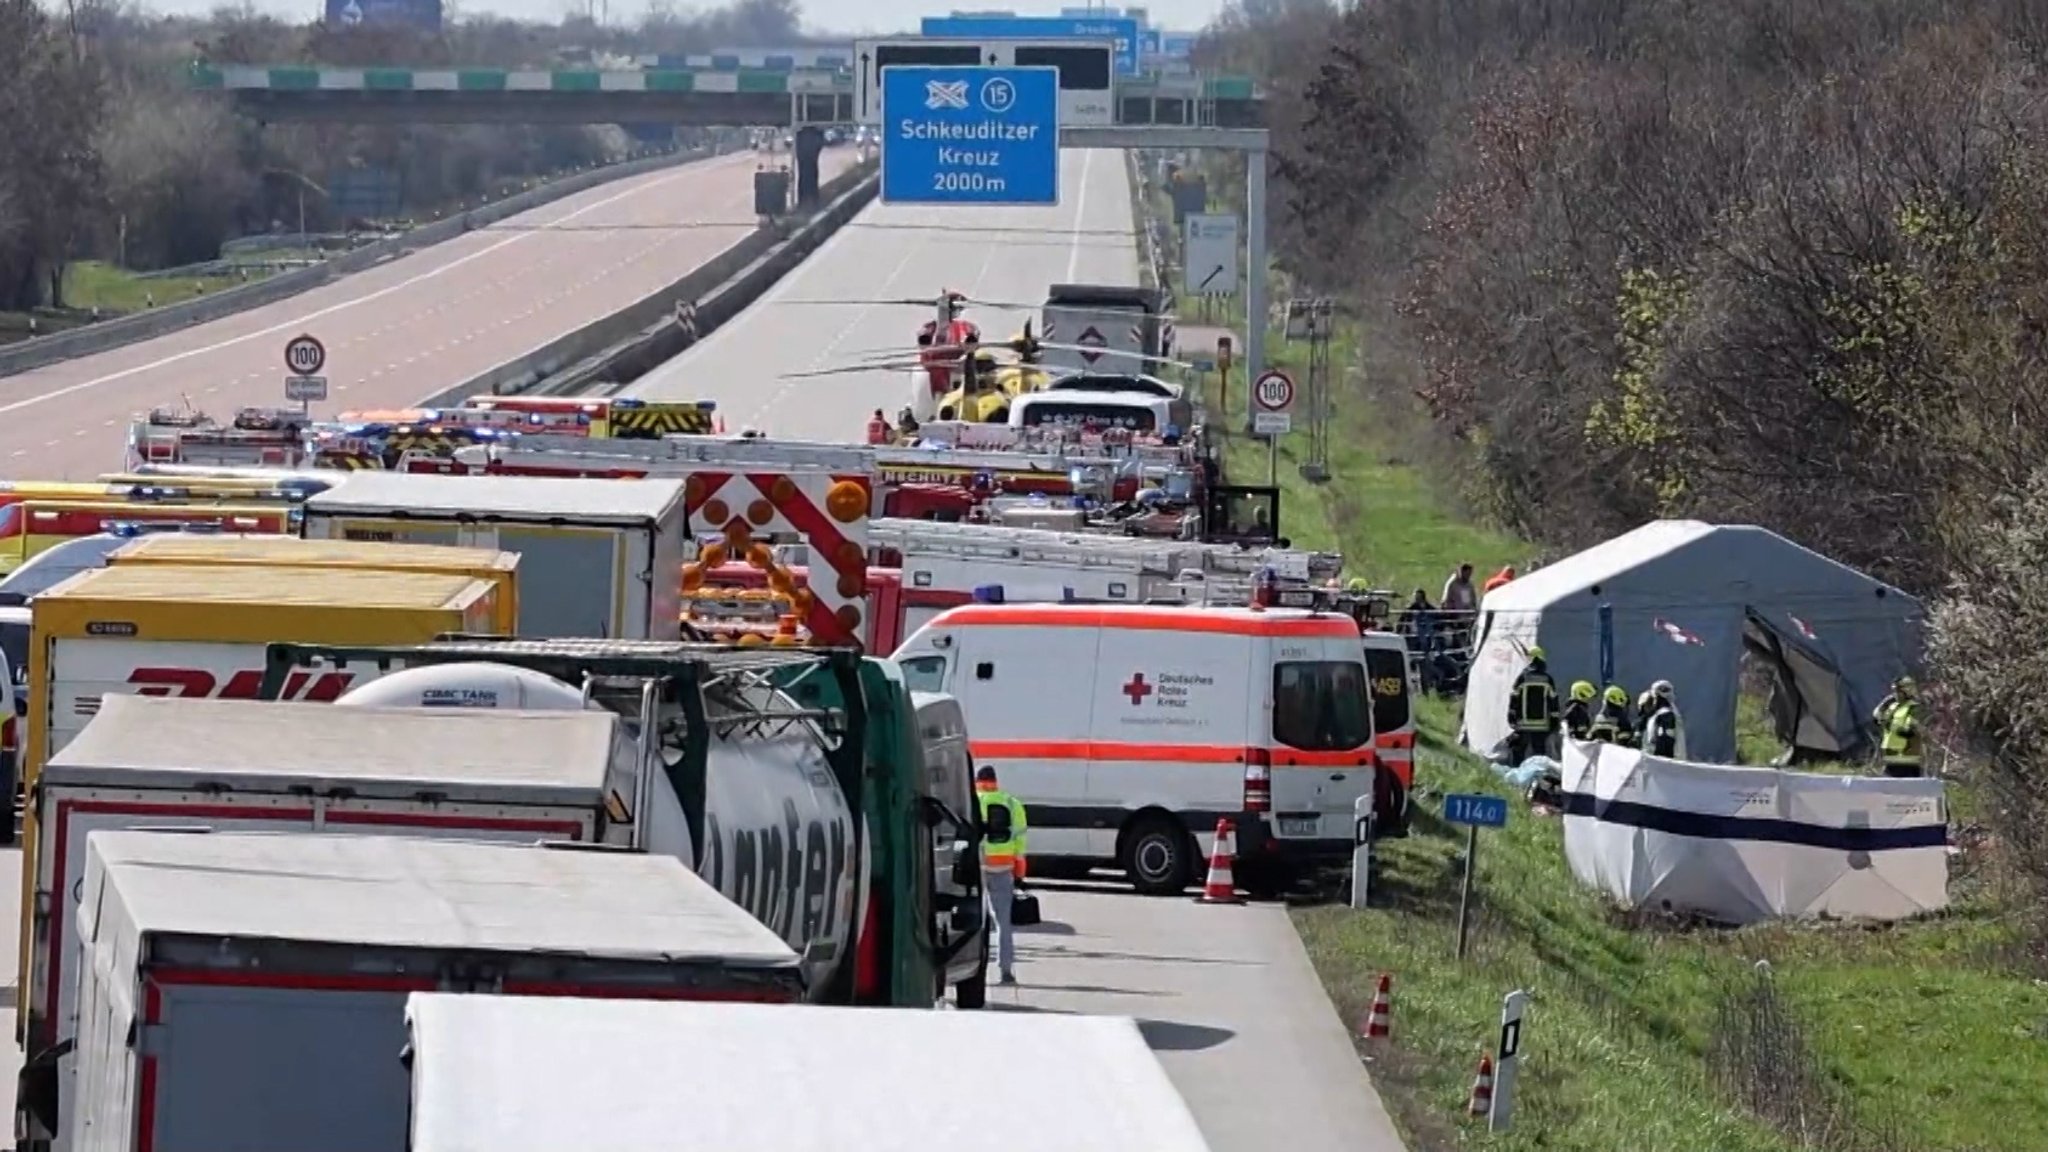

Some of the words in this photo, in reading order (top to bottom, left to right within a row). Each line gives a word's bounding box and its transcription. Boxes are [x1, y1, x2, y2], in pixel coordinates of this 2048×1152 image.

[990, 85, 1008, 105] 15
[901, 118, 1039, 140] Schkeuditzer
[938, 147, 1000, 166] Kreuz
[295, 346, 318, 365] 100
[1263, 381, 1287, 401] 100
[1158, 673, 1214, 685] Deutsches
[1157, 685, 1188, 696] Rotes
[1157, 697, 1188, 708] Kreuz
